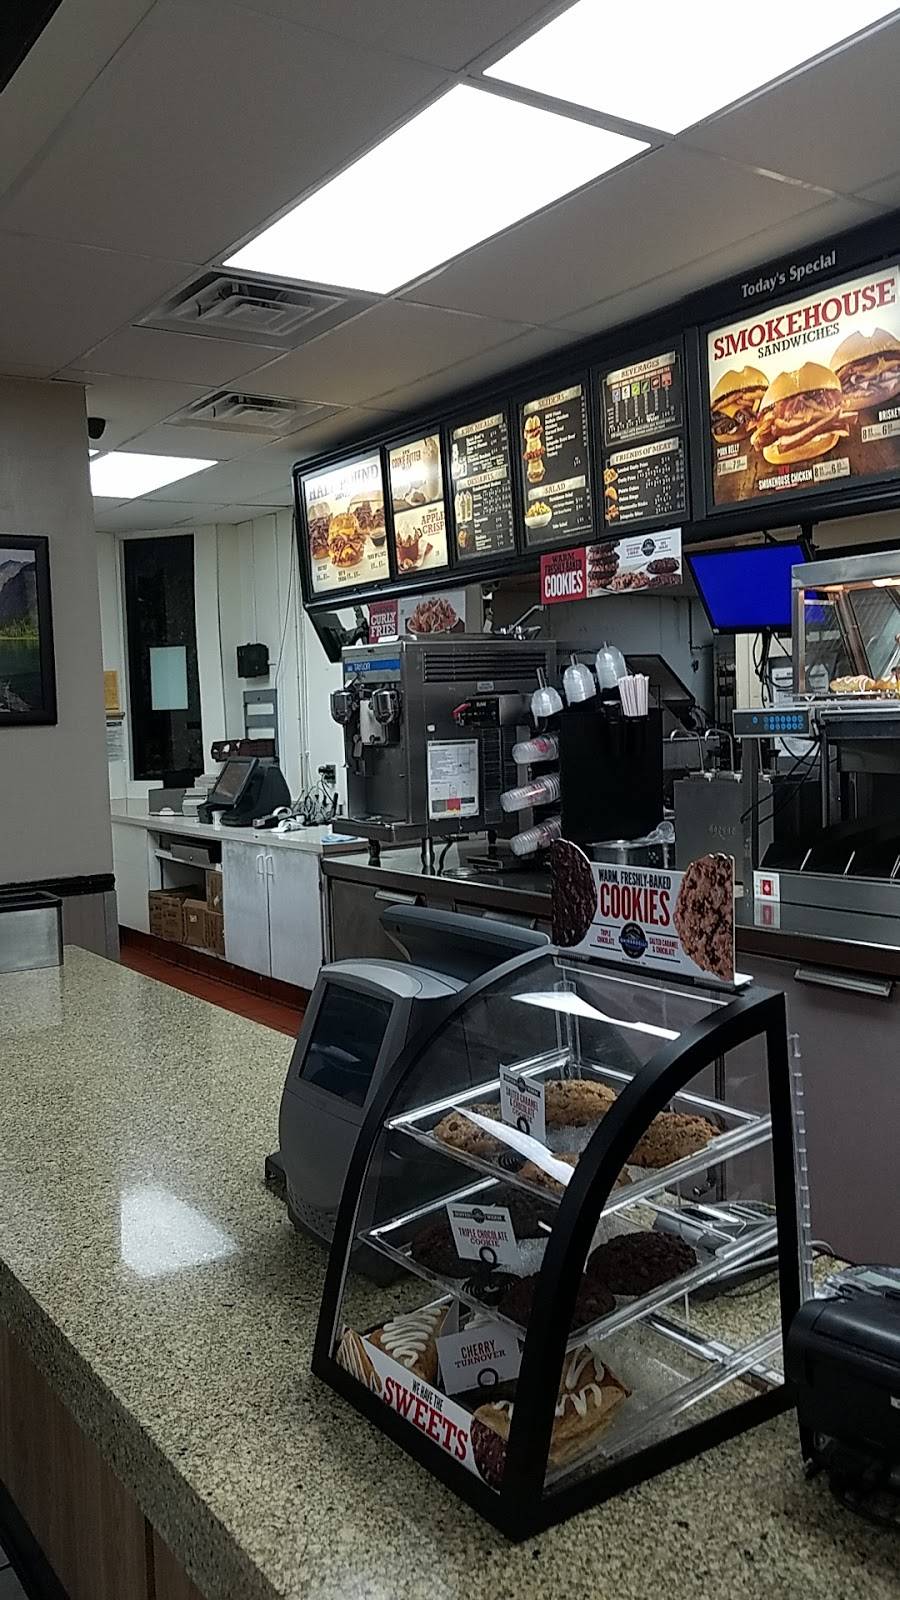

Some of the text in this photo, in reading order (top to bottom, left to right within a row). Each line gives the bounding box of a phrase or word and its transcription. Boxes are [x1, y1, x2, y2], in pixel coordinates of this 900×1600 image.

[741, 250, 836, 298] Today's Special
[713, 278, 896, 361] SMOKEHOUSE
[757, 322, 840, 359] SANDWICHES
[621, 358, 660, 378] BEVERAGES
[615, 442, 672, 462] FRIENDS OF MEAT
[717, 443, 740, 457] PORK BELLY
[309, 485, 334, 501] HAL
[340, 464, 379, 490] PUND
[544, 482, 566, 494] SALAD
[758, 473, 790, 491] SMOKEHOUSE
[790, 468, 813, 484] CHICKEN
[422, 521, 444, 534] CRISP
[551, 552, 575, 562] WARM
[544, 569, 583, 599] COOKIES
[371, 611, 397, 626] CURLY
[371, 623, 396, 638] FRIES
[599, 869, 672, 890] WARM, FRESHLY-BAKED
[600, 883, 671, 927] COOKIES
[520, 1092, 539, 1112] CARAMEL
[458, 1227, 508, 1242] TRIPLE CHOCOLATE
[471, 1237, 500, 1247] COOKIE
[454, 1349, 506, 1368] TURNOVER
[460, 1339, 495, 1359] CHERRY
[412, 1378, 444, 1412] WE HAVE THE
[383, 1376, 469, 1461] SWEETS
